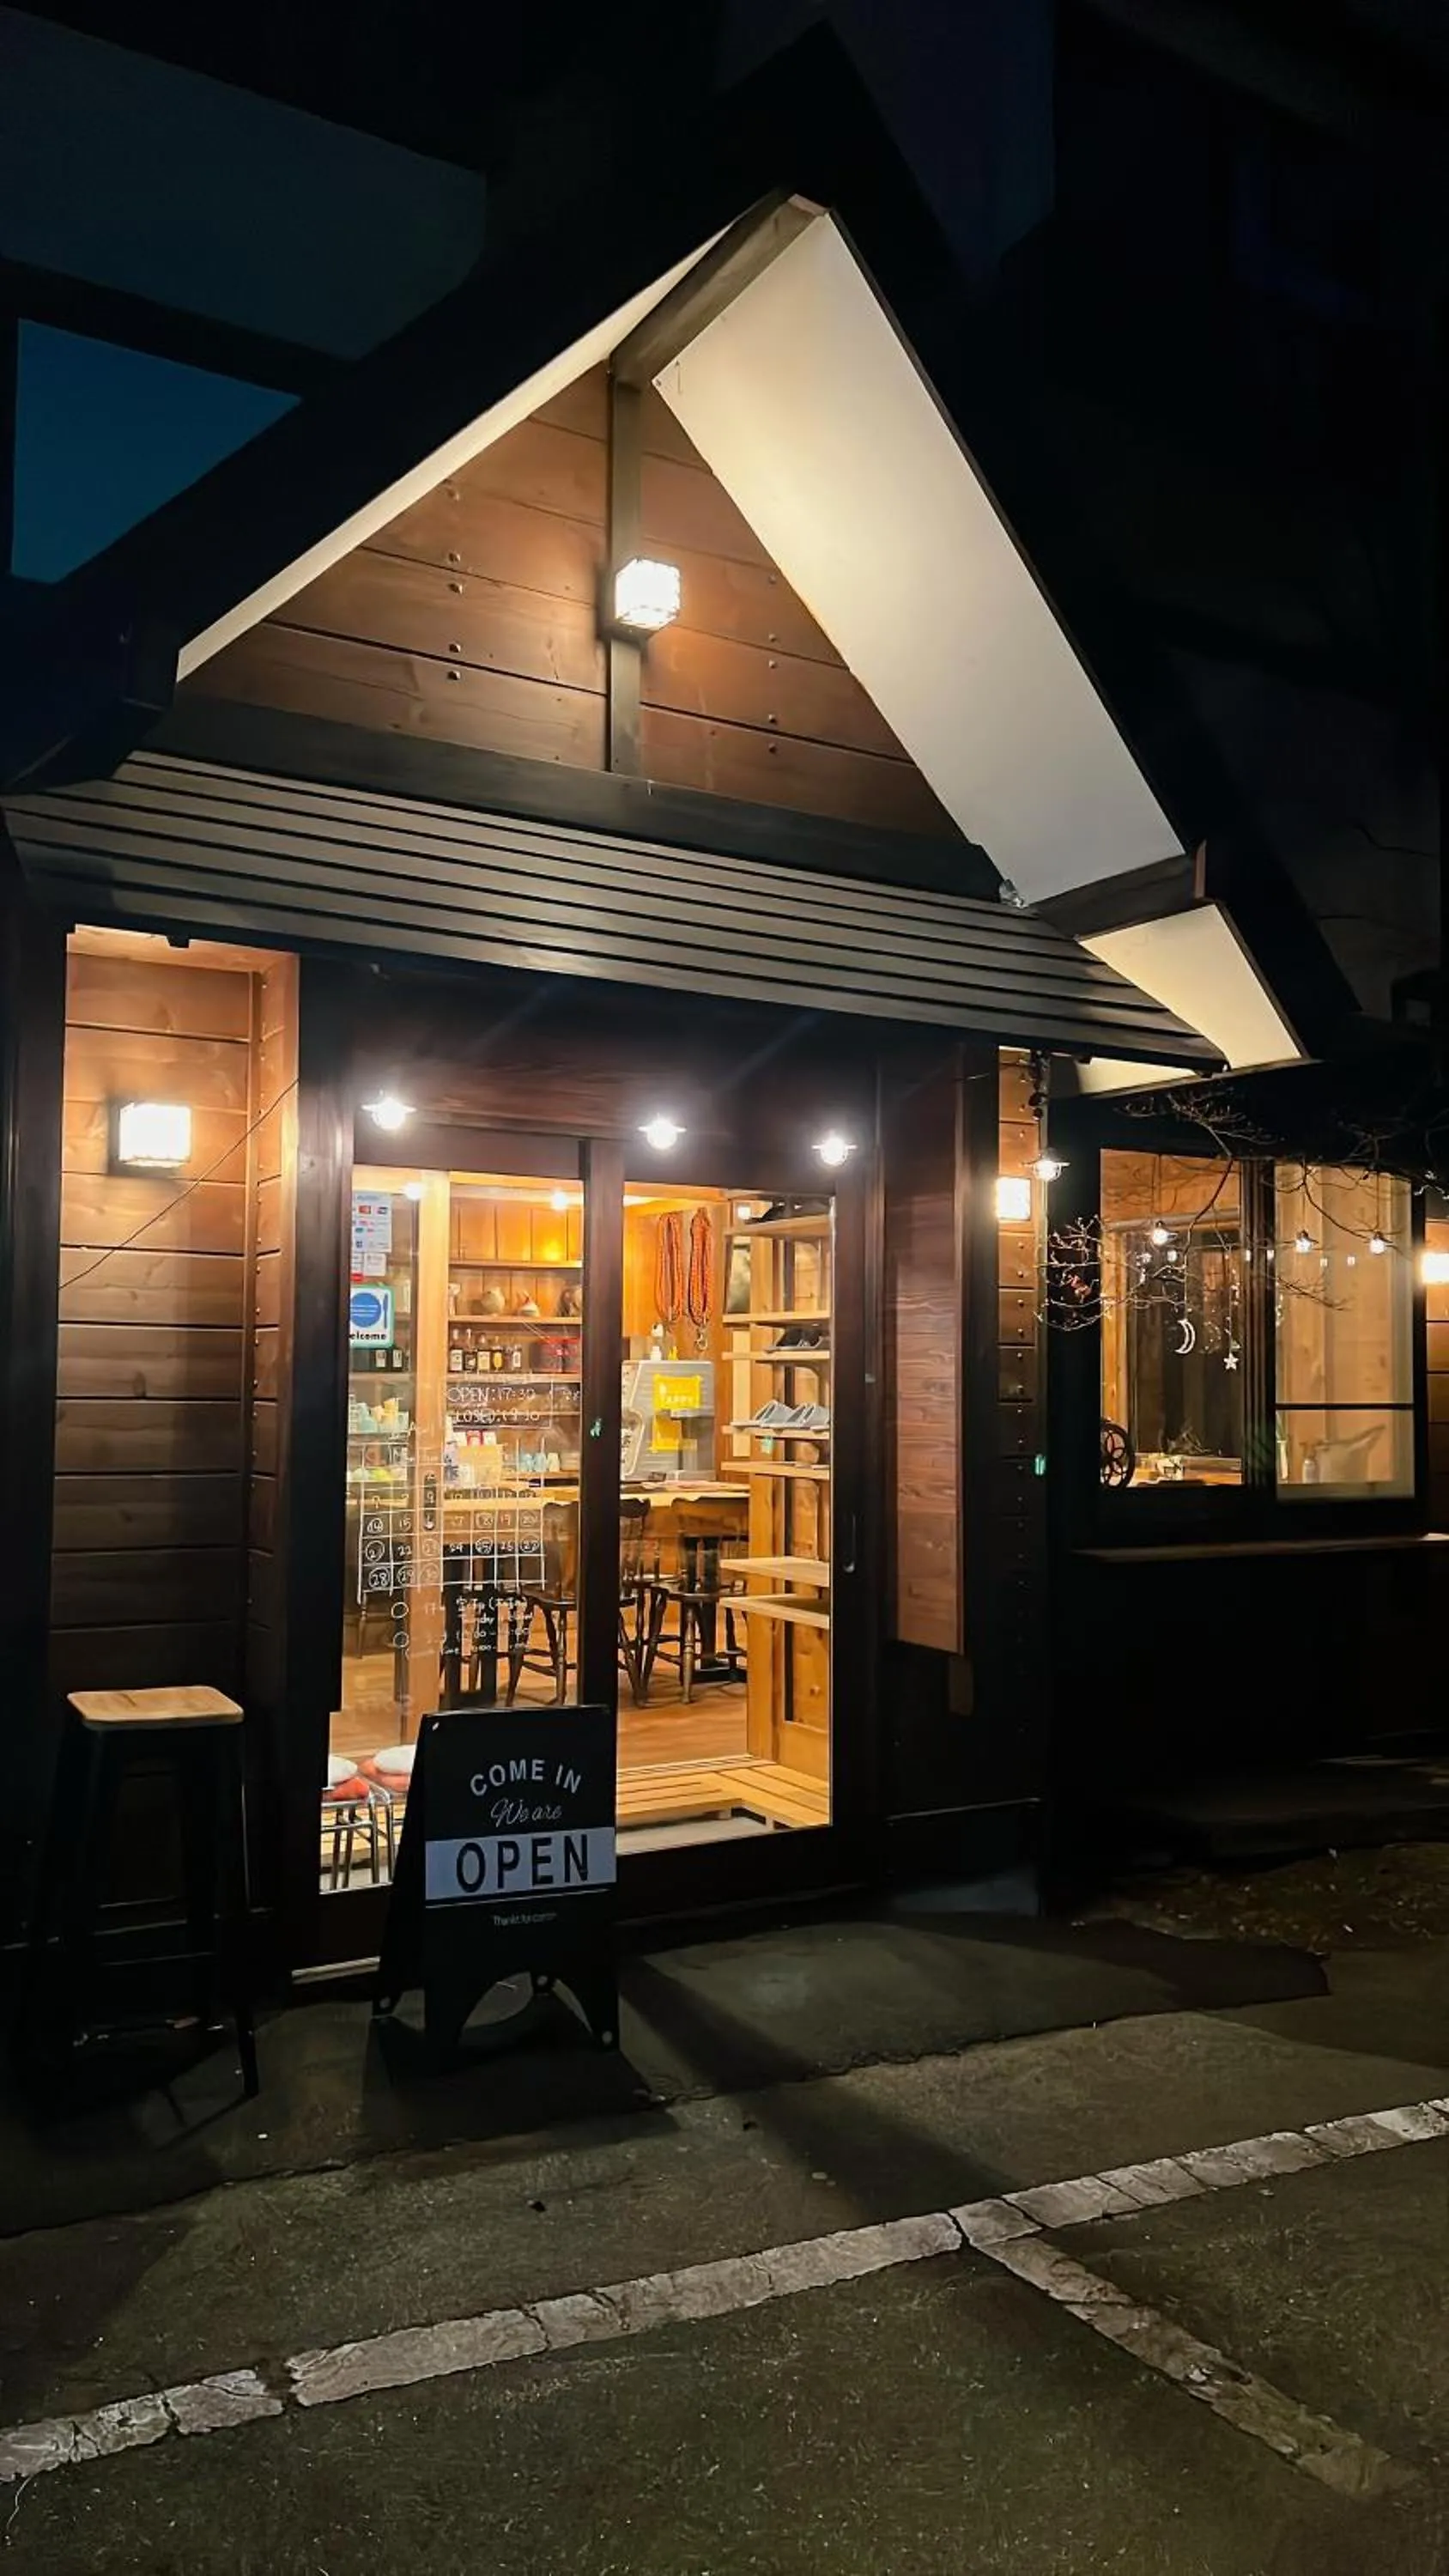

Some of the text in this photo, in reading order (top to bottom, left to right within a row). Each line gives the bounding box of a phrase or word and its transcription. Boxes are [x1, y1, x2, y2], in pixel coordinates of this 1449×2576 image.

[349, 1330, 386, 1340] elcome
[470, 1759, 581, 1796] COME IN
[490, 1797, 562, 1827] We are
[456, 1834, 588, 1893] OPEN
